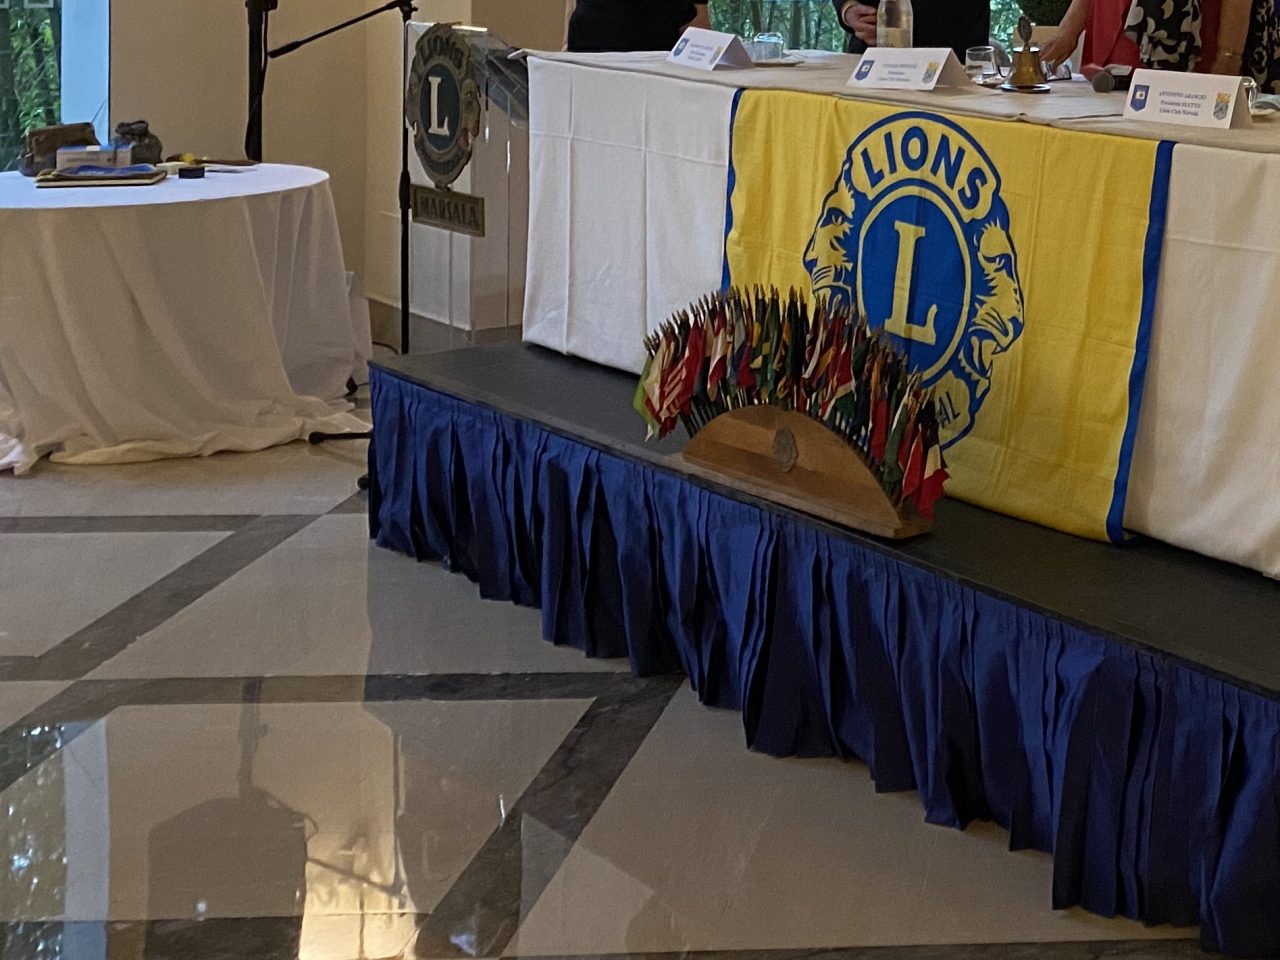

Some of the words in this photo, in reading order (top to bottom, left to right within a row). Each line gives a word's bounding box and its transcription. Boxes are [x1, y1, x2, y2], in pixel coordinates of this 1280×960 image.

[419, 34, 465, 70] LIONS
[428, 76, 450, 136] L
[860, 125, 988, 210] LIONS
[419, 194, 480, 228] MARSALA
[884, 219, 938, 346] L
